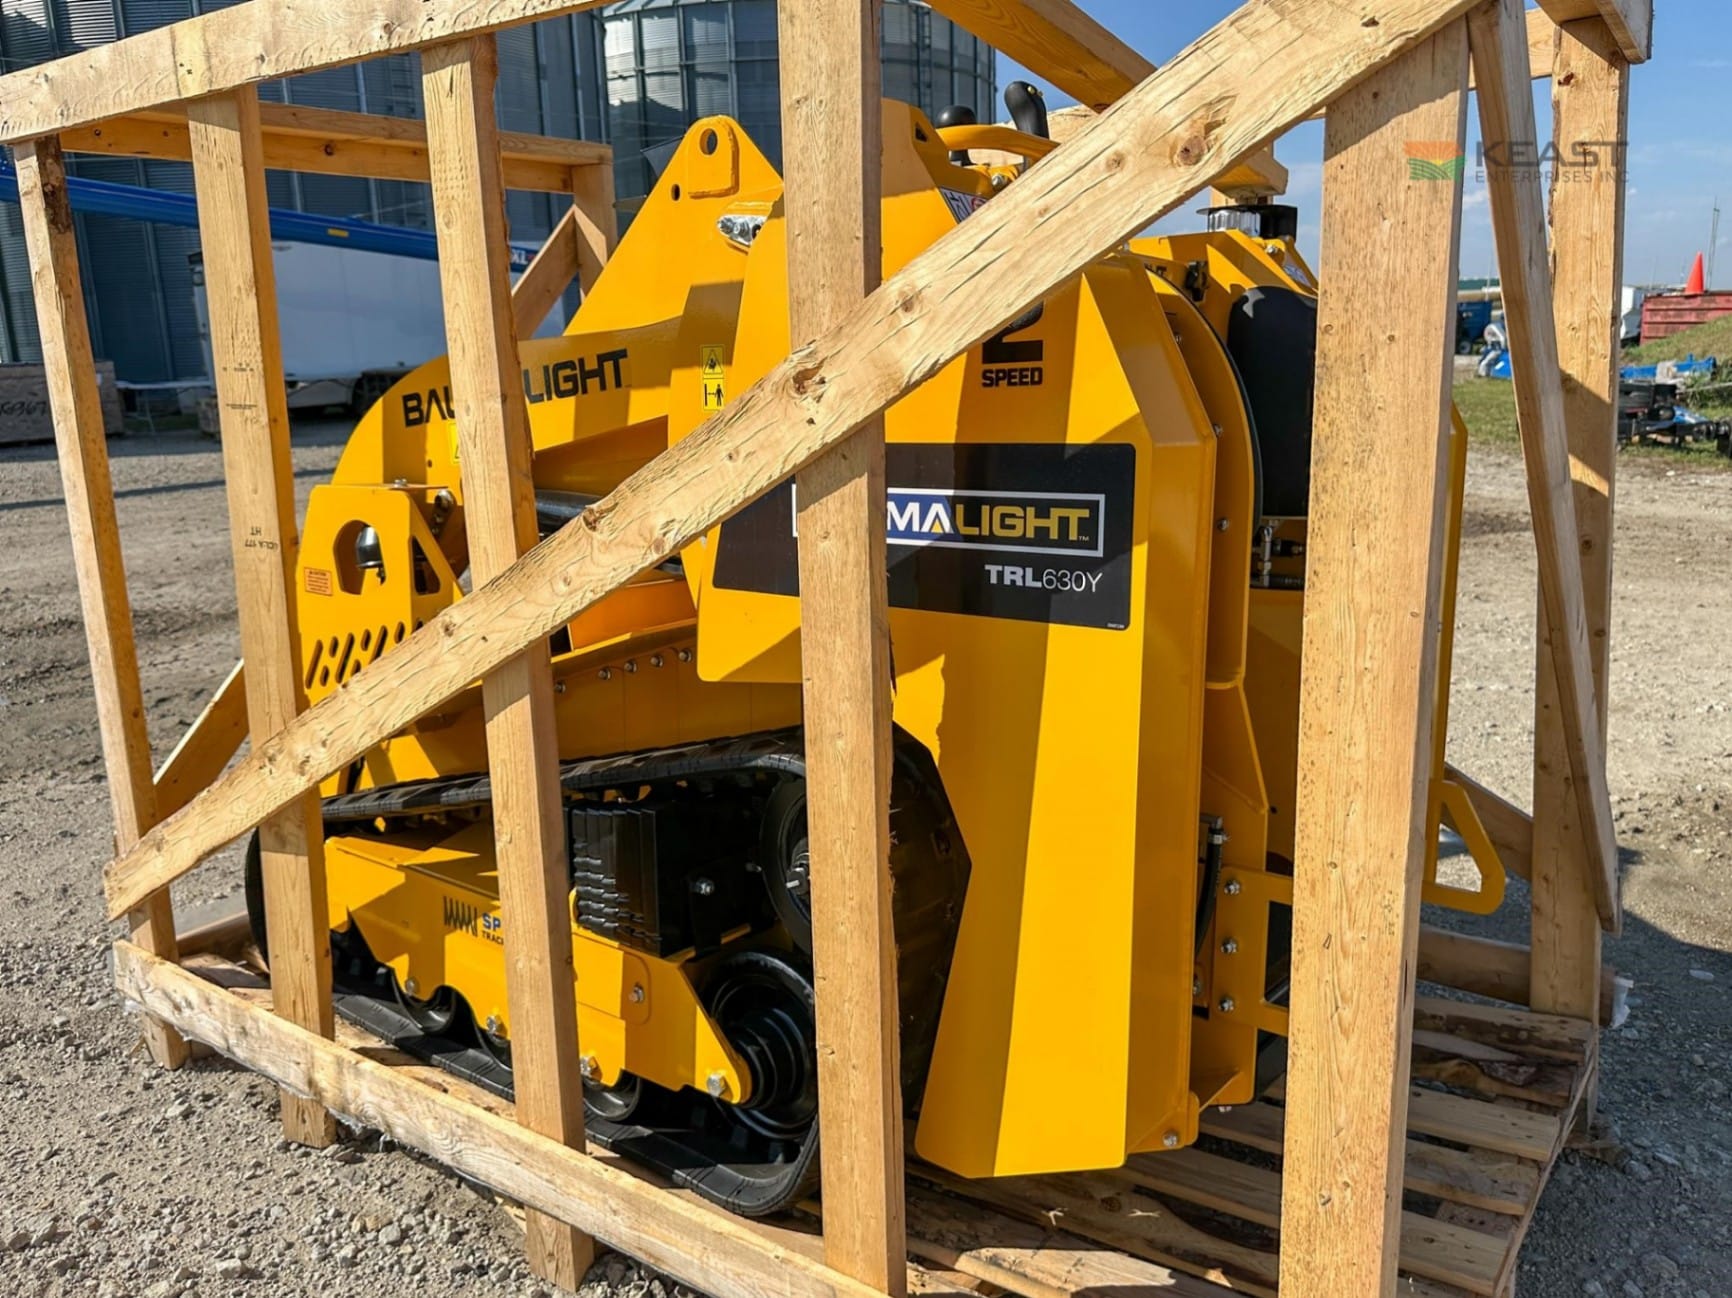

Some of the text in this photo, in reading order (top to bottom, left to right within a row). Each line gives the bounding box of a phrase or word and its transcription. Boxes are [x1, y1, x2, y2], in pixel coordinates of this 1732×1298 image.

[982, 367, 1043, 387] SPEED
[887, 501, 1090, 541] MALIGHT
[984, 563, 1104, 593] TRL630Y
